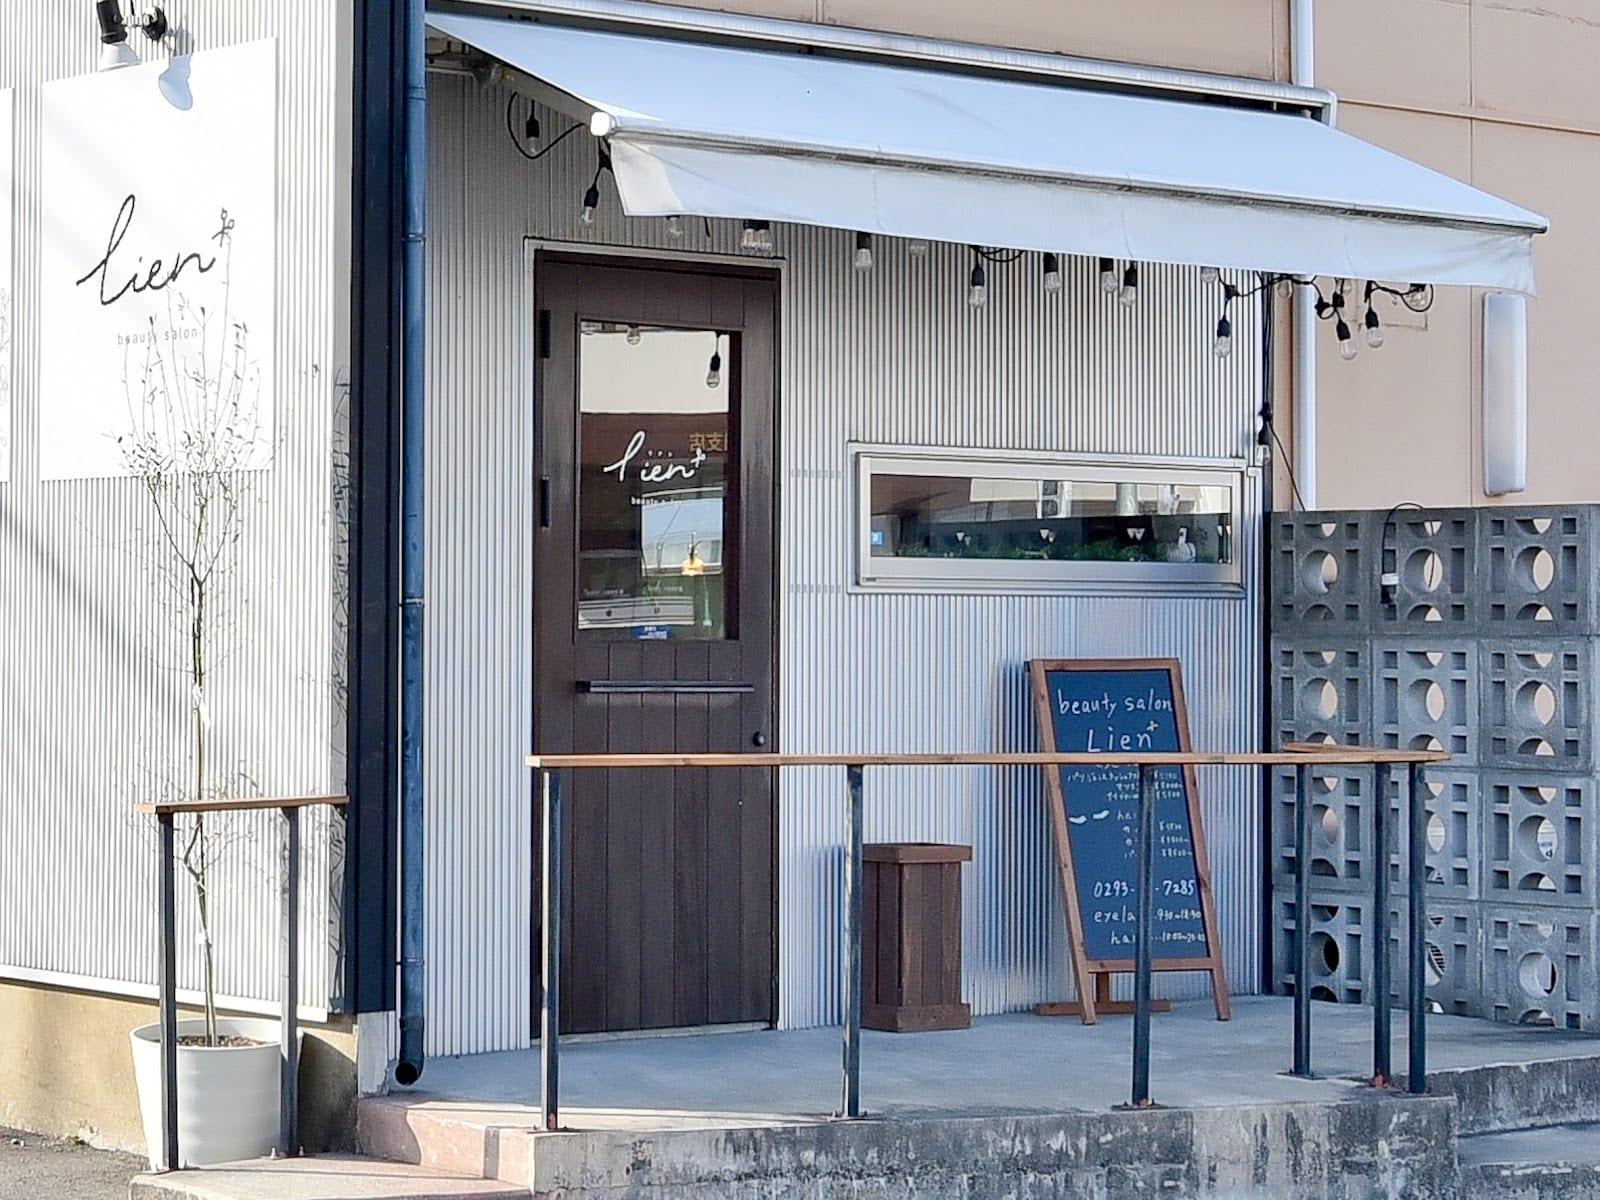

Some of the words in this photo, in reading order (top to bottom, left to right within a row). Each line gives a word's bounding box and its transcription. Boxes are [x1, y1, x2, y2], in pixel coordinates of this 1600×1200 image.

[75, 193, 217, 306] lien
[163, 326, 198, 341] salon
[602, 430, 695, 483] lien
[1057, 688, 1117, 718] beauty
[1124, 688, 1173, 712] salon
[1087, 726, 1153, 753] Lien
